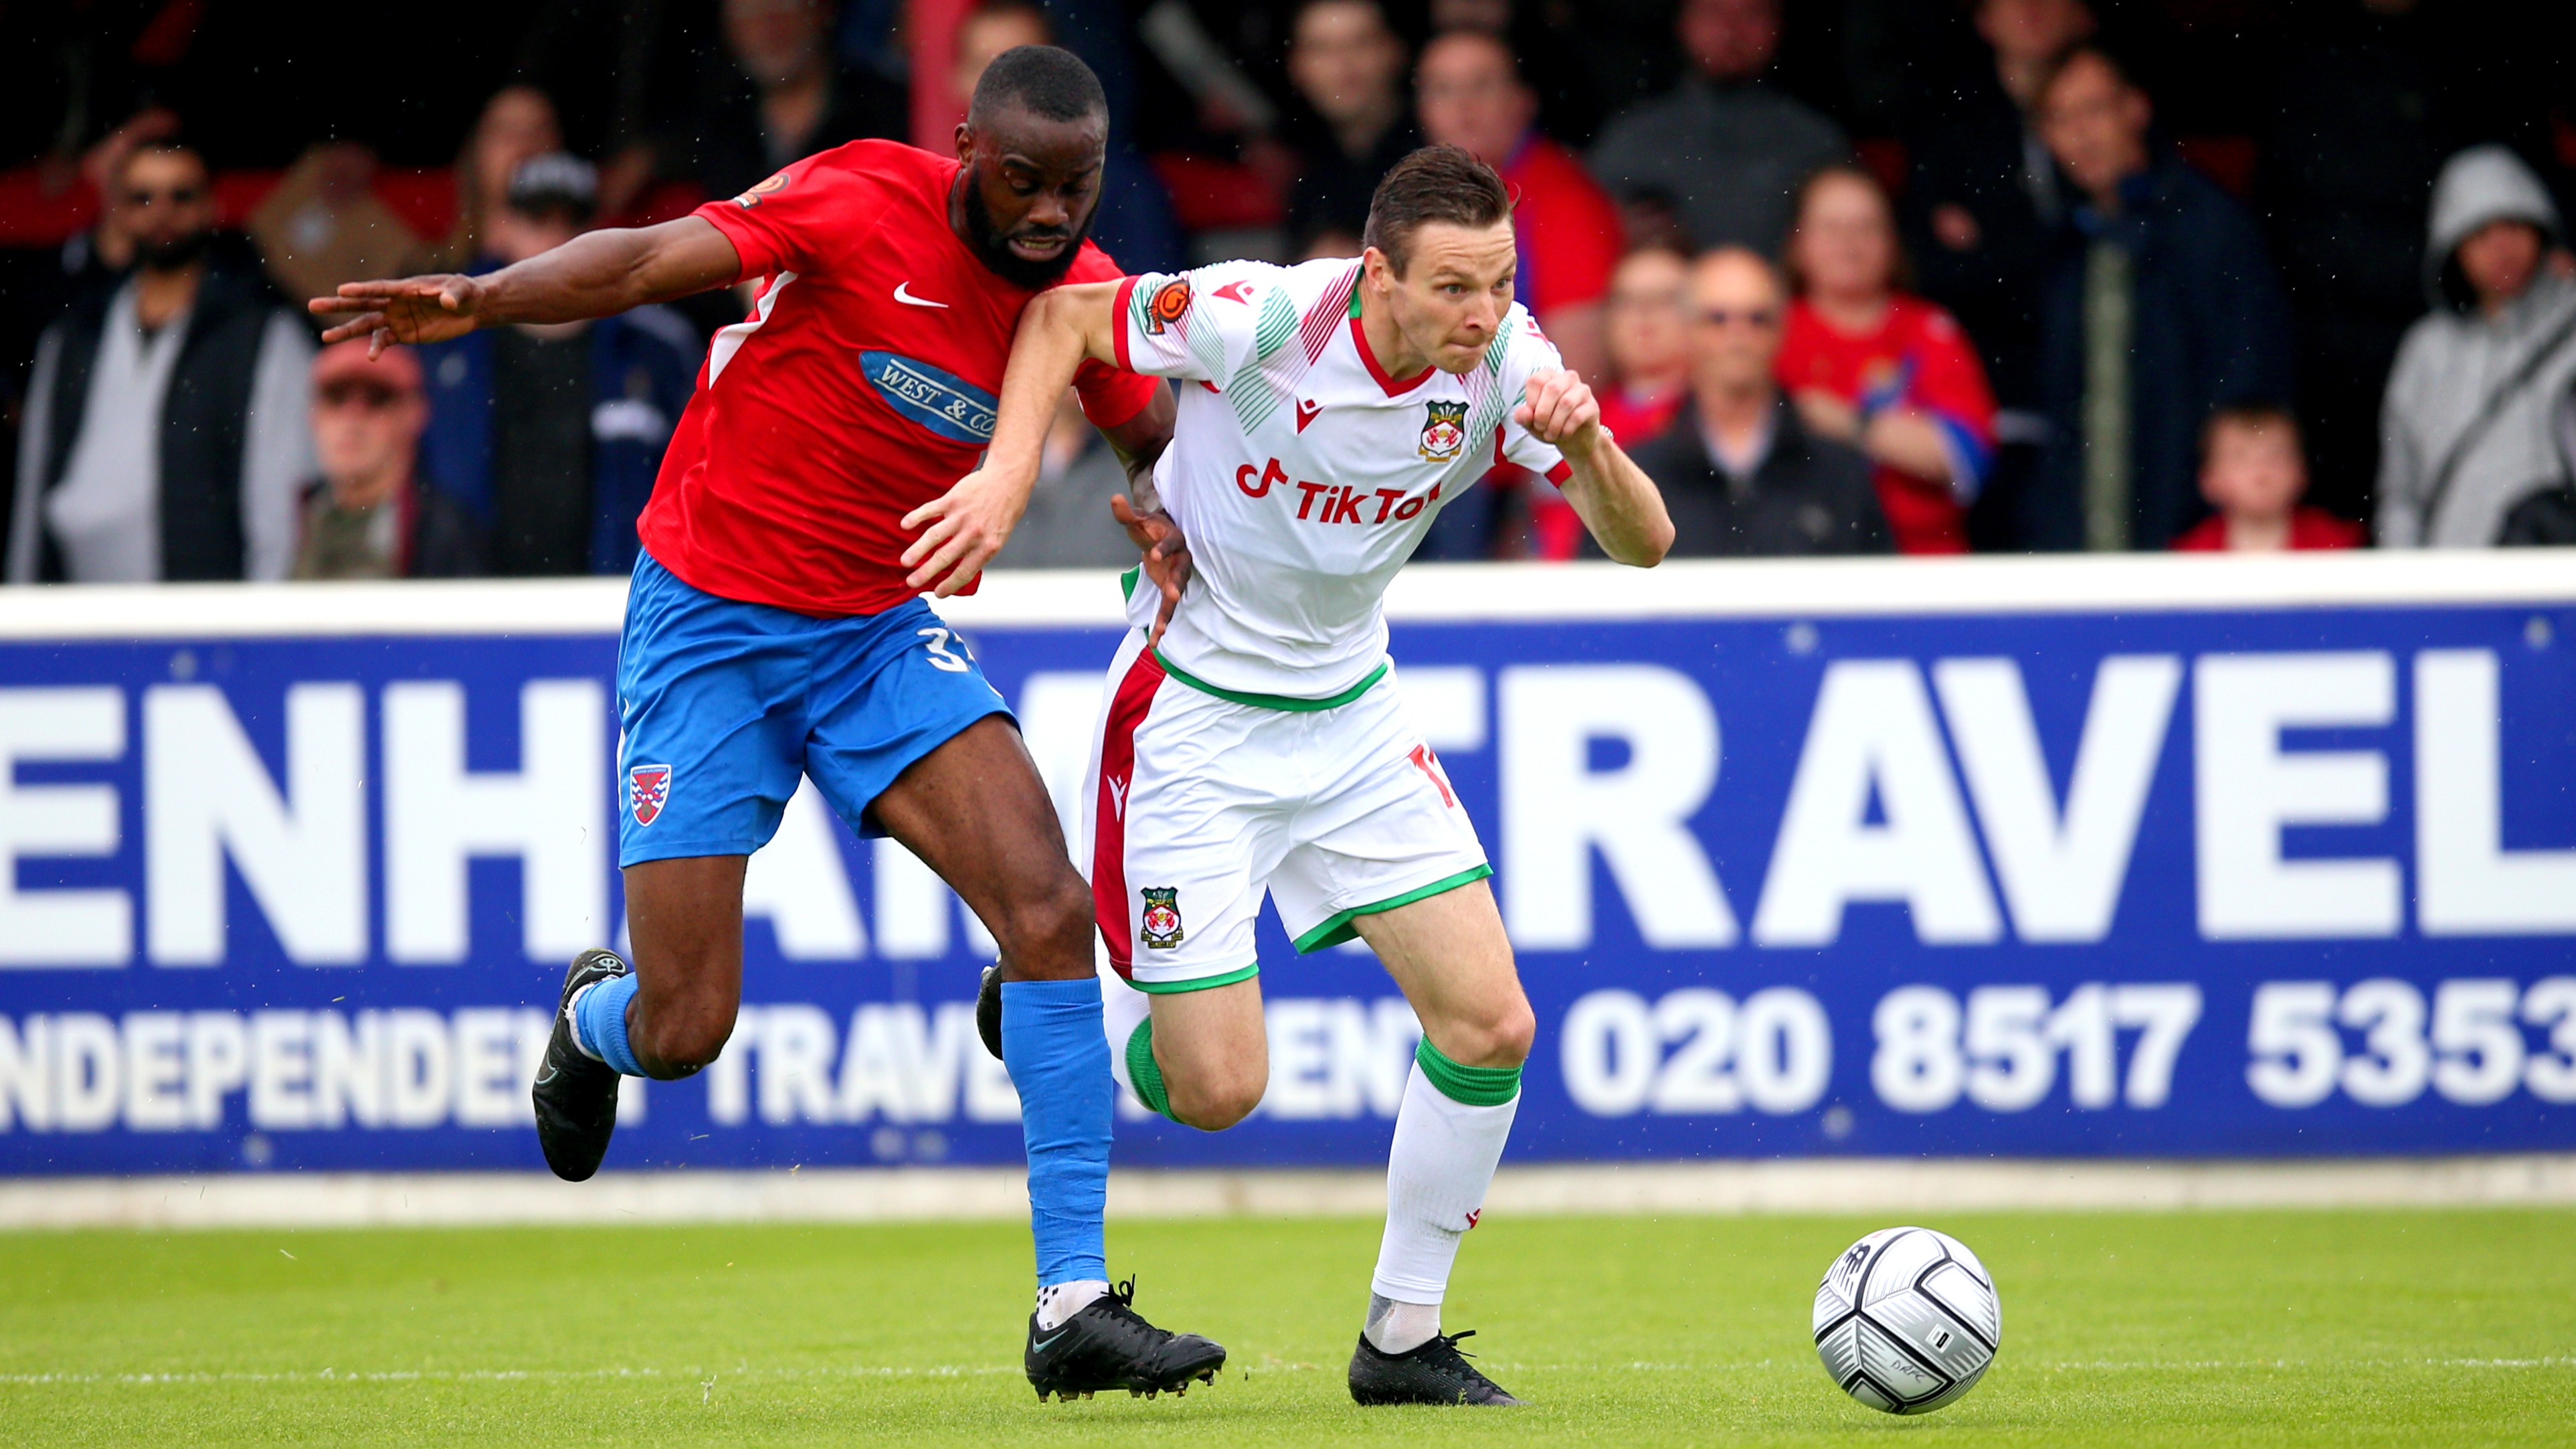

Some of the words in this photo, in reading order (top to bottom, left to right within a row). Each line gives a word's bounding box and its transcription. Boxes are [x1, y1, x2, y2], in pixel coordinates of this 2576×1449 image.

[881, 365, 941, 404] WEST
[944, 400, 966, 420] &
[970, 414, 997, 432] CO
[706, 1003, 1024, 1126] TRAVE
[1562, 987, 1831, 1116] 020
[1871, 985, 2201, 1112] 8517
[2248, 978, 2576, 1108] 5353
